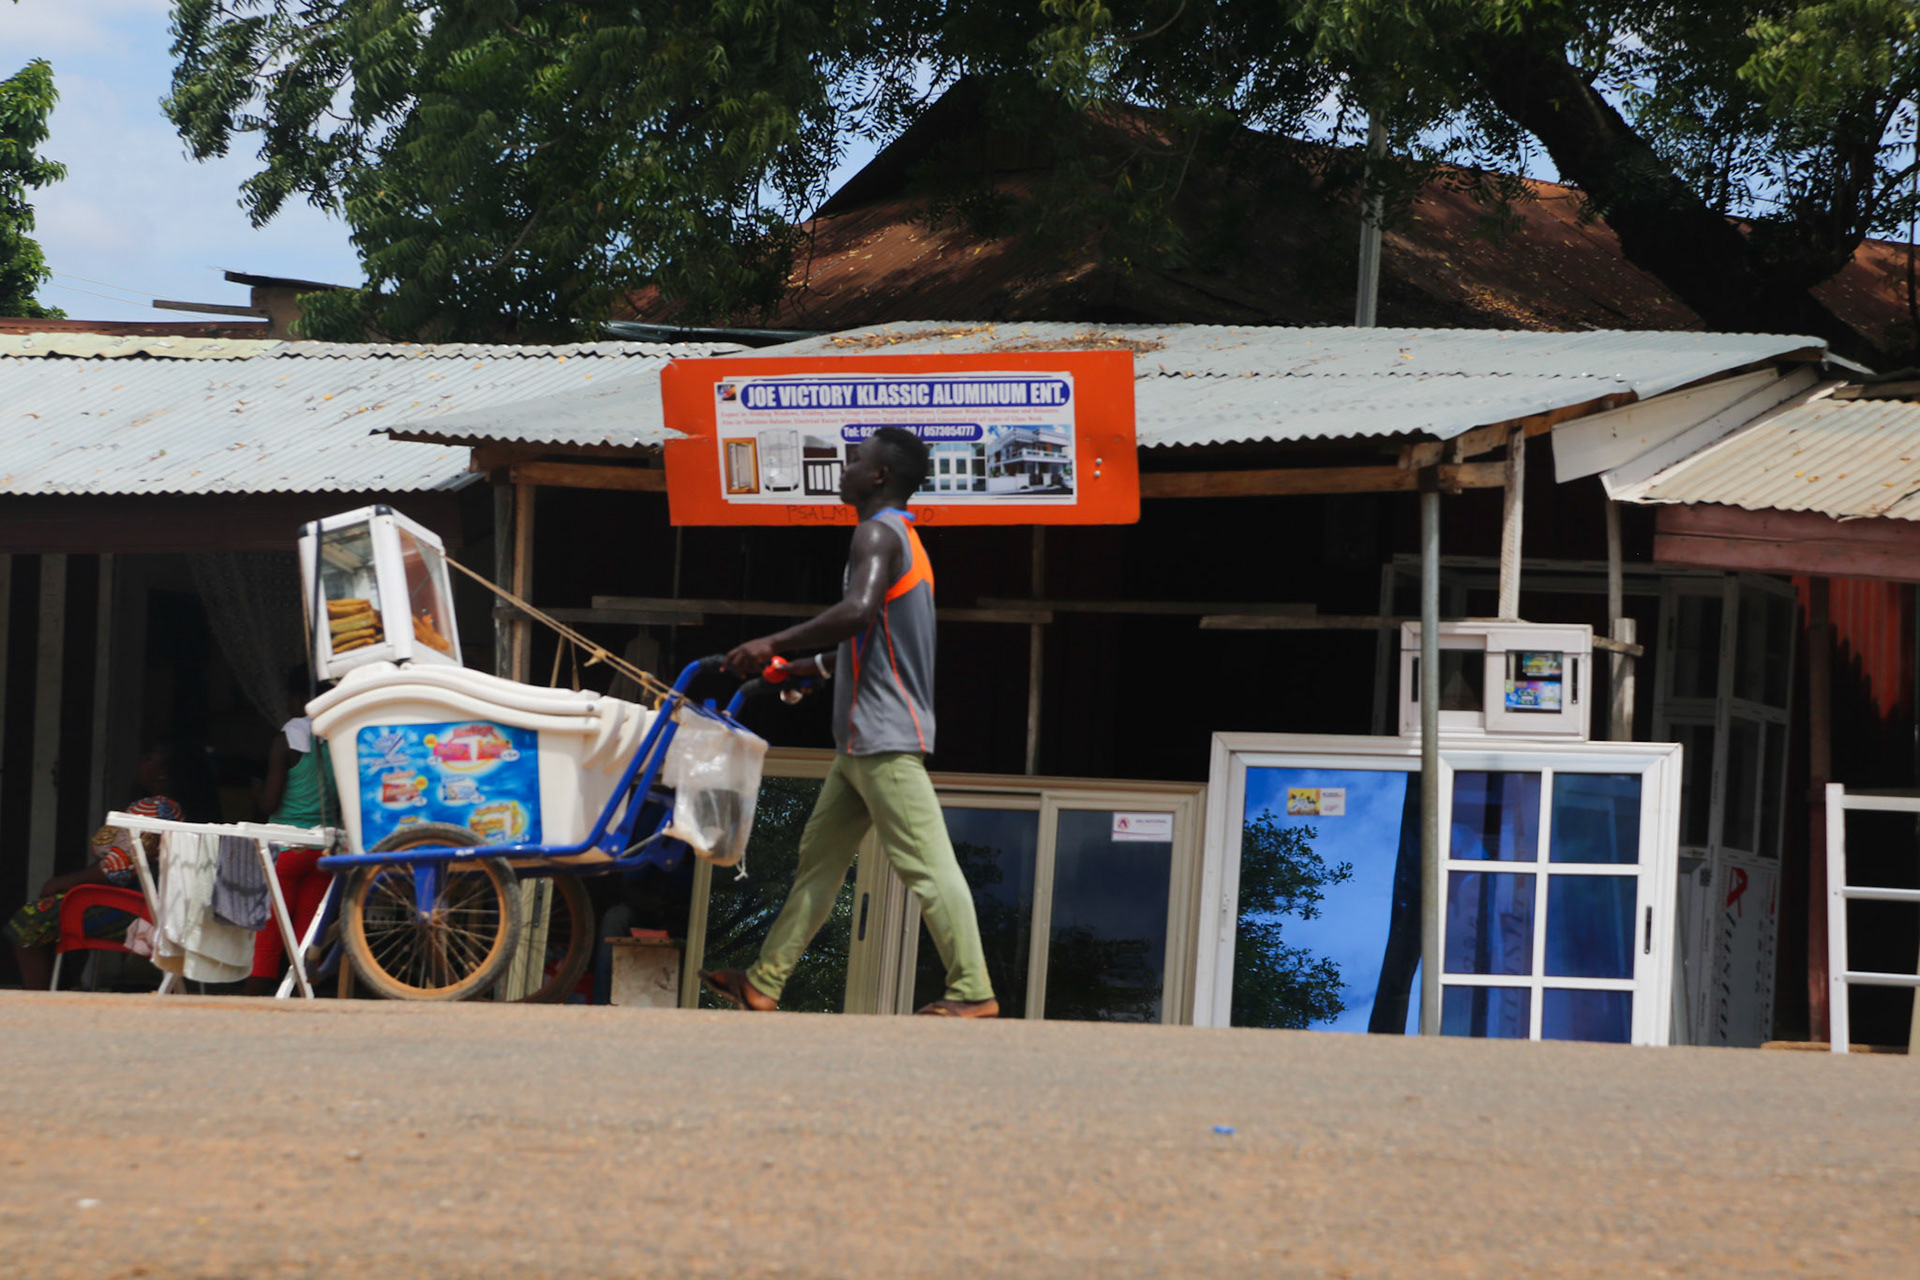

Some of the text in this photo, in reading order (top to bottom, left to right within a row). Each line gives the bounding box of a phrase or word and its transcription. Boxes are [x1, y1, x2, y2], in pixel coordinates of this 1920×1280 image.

[747, 382, 1066, 407] JOE VICTORY KLASSIC ALUMINUM ENT.
